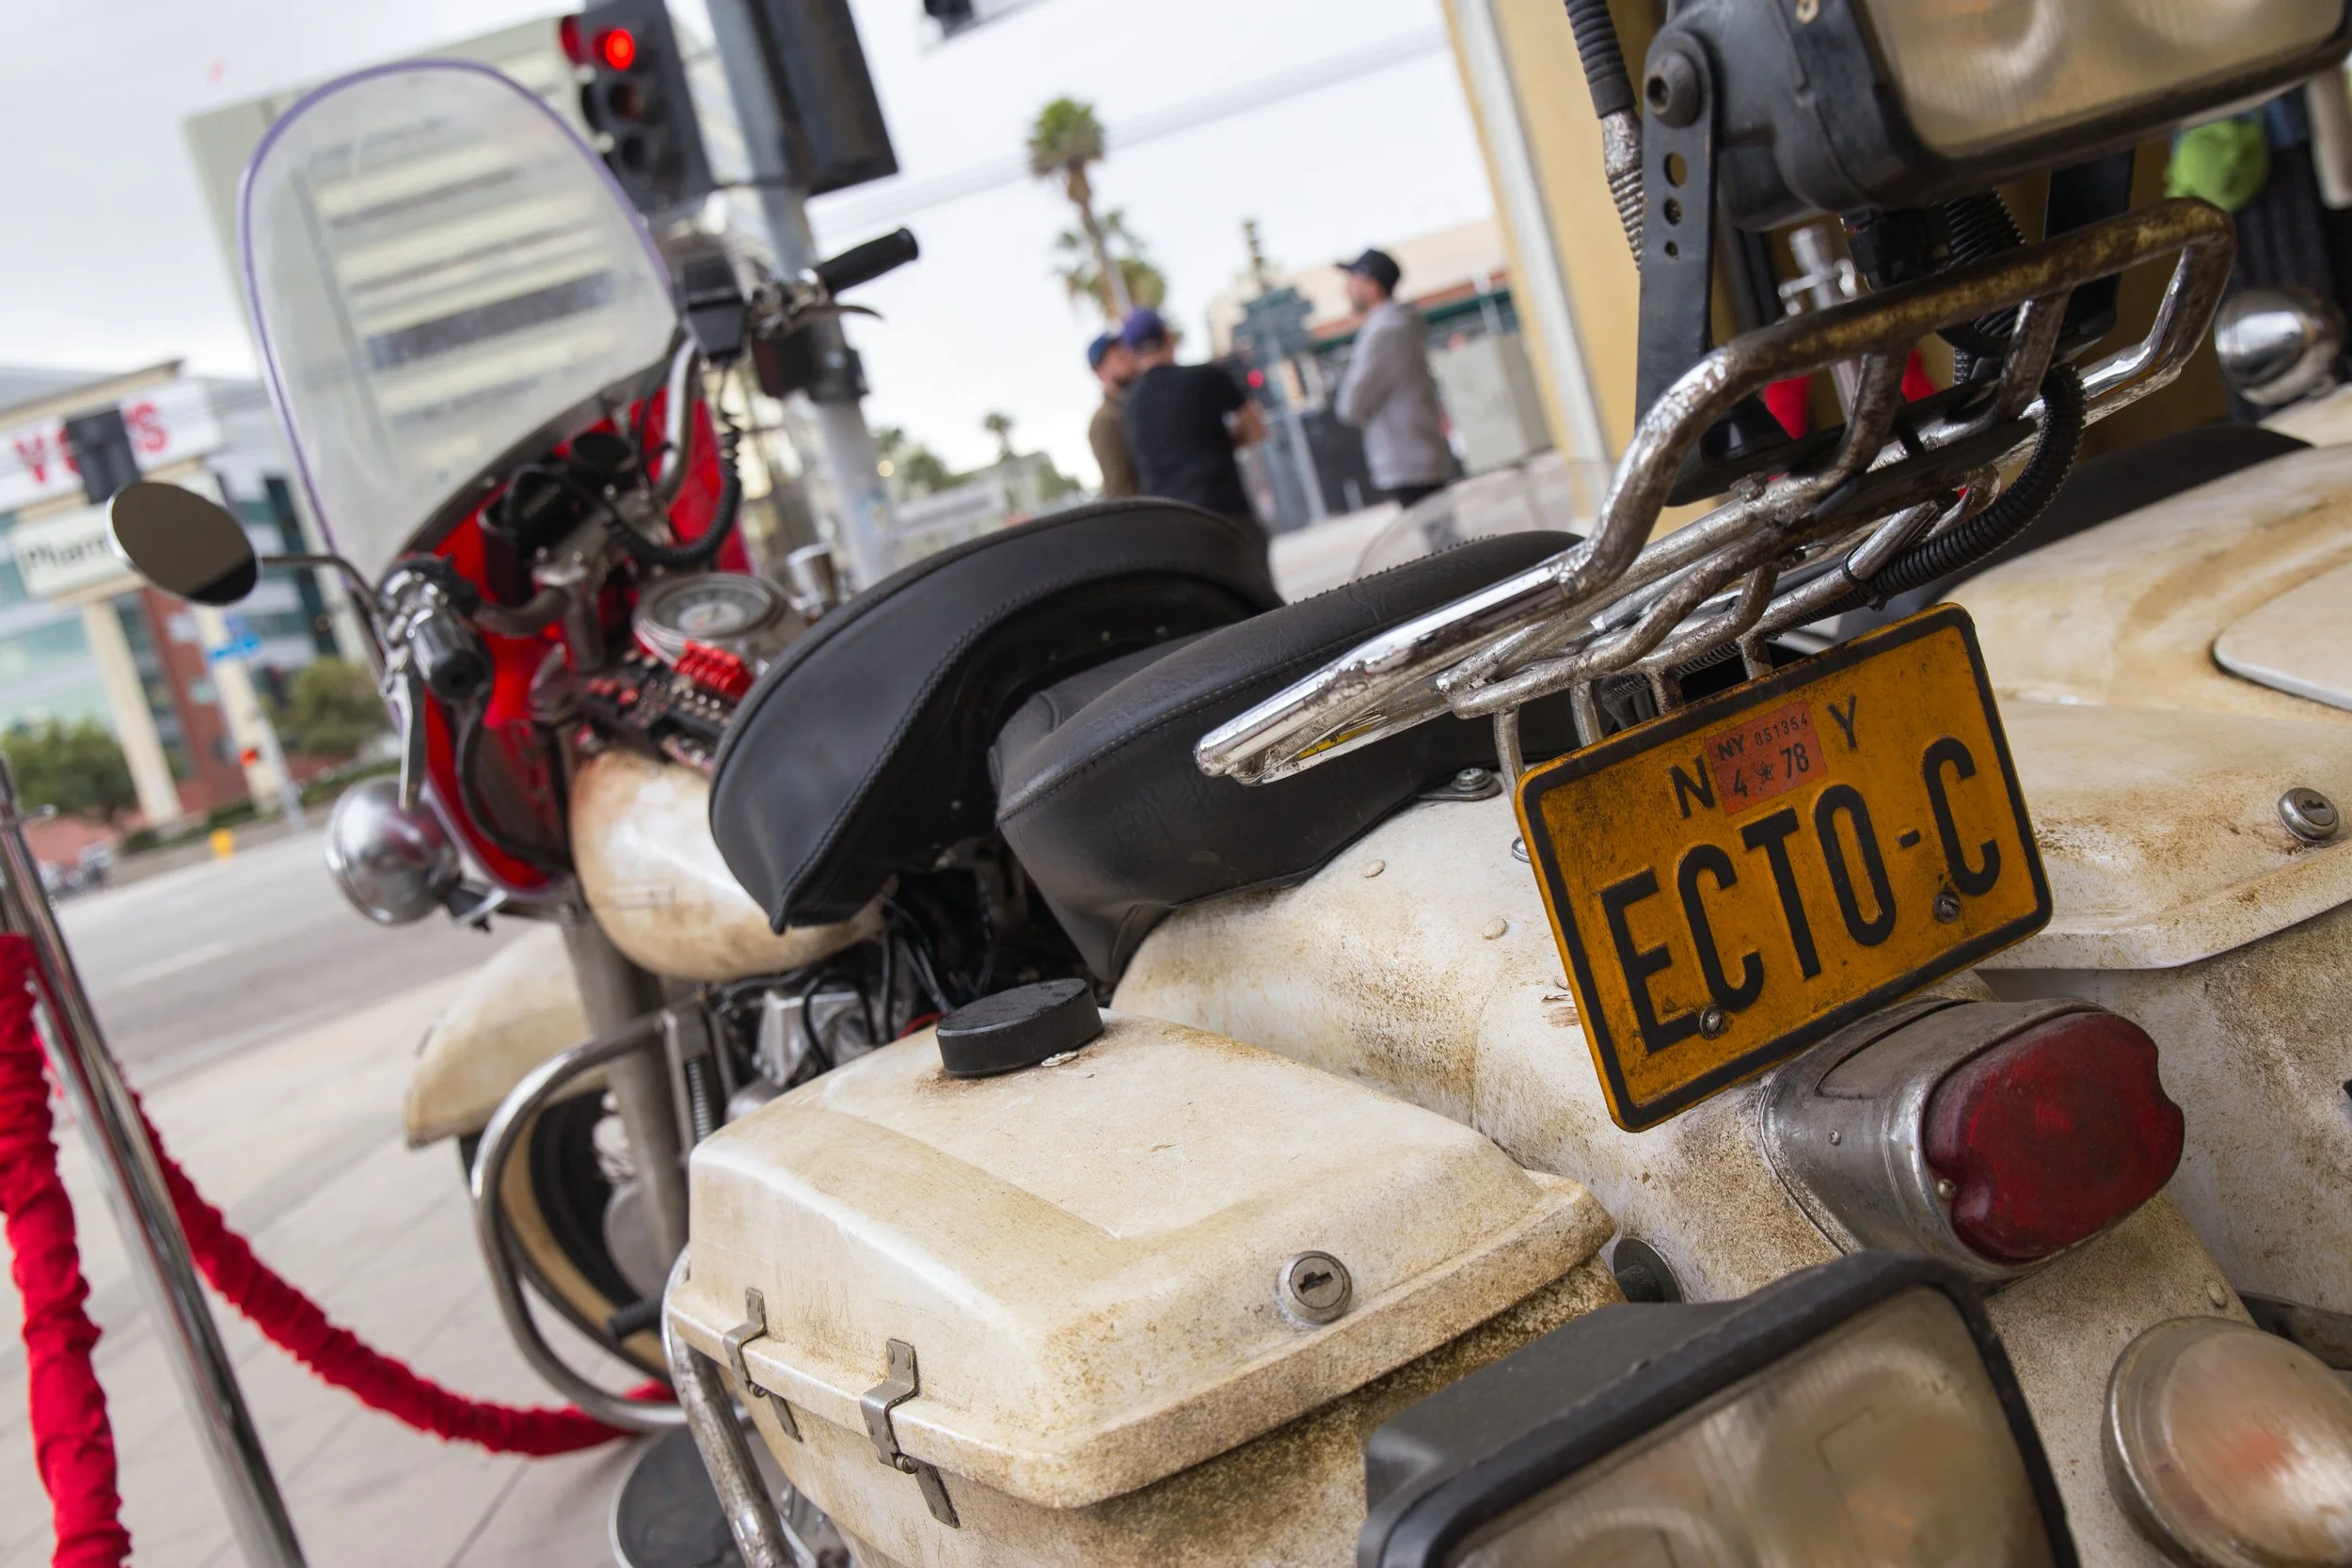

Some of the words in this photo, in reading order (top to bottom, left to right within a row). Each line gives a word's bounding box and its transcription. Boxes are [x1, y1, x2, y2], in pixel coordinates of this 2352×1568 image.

[1670, 755, 1715, 818] N
[1827, 693, 1858, 750] Y
[1717, 734, 1745, 761] NY
[1754, 713, 1808, 746] 051354
[1734, 768, 1748, 798] 4
[1779, 742, 1809, 779] 78
[1599, 736, 2001, 1055] ECTO-C
